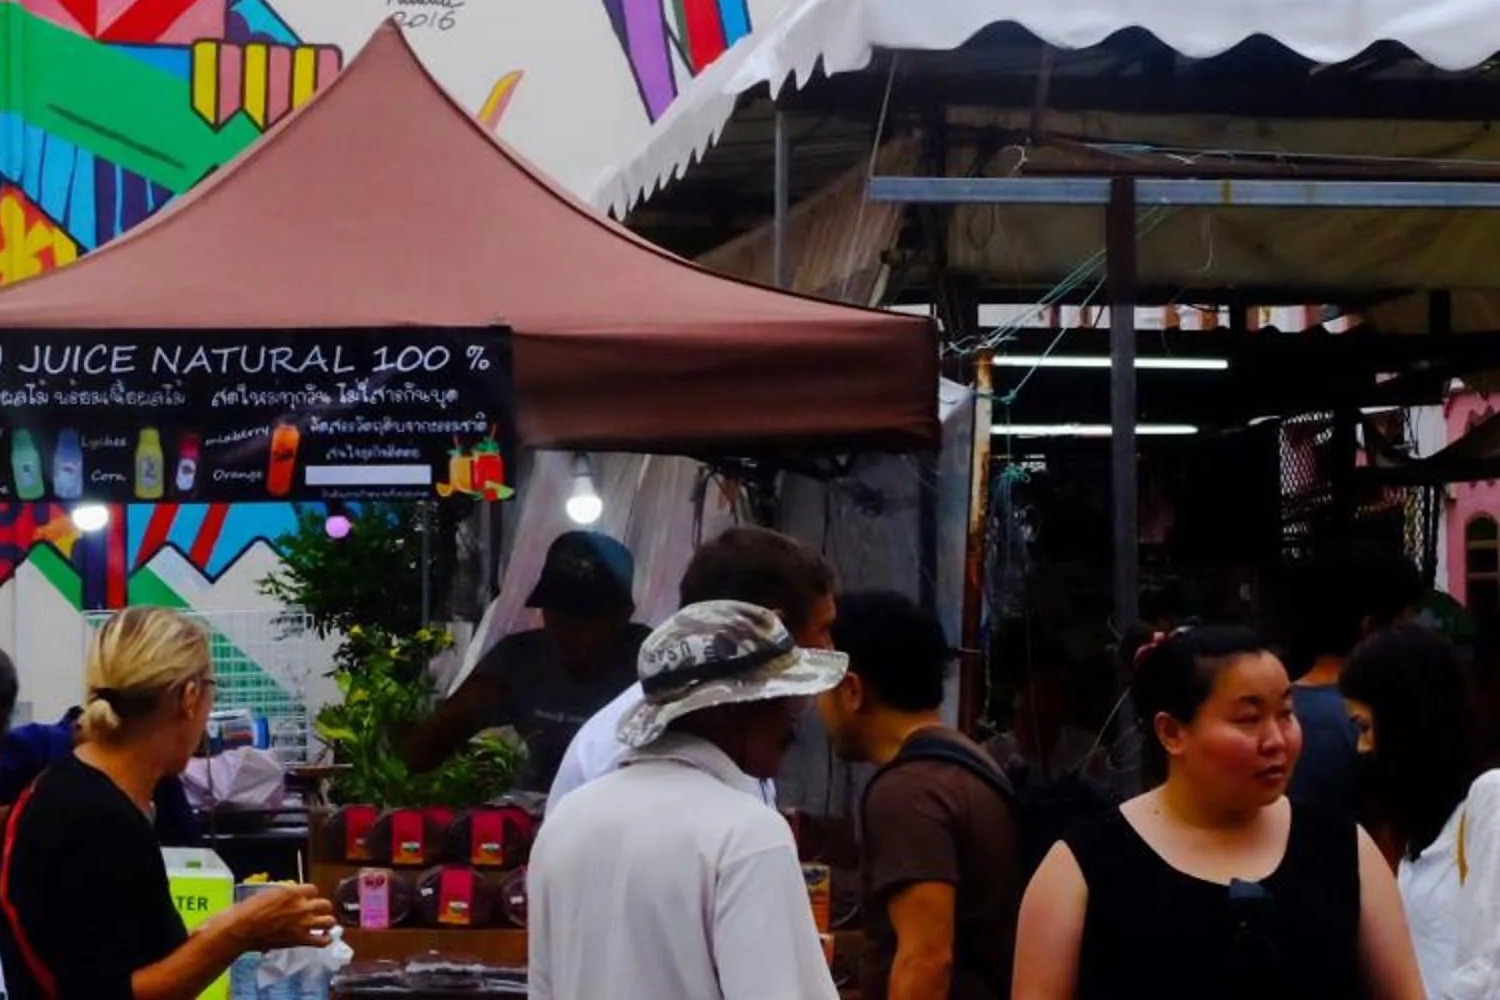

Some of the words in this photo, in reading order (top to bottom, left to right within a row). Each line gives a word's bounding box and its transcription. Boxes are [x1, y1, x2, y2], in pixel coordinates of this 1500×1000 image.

[391, 10, 456, 31] 2016
[17, 344, 138, 375] JUICE
[151, 345, 355, 374] NATURAL
[372, 345, 450, 372] 100
[466, 345, 490, 370] %
[175, 895, 209, 912] TER
